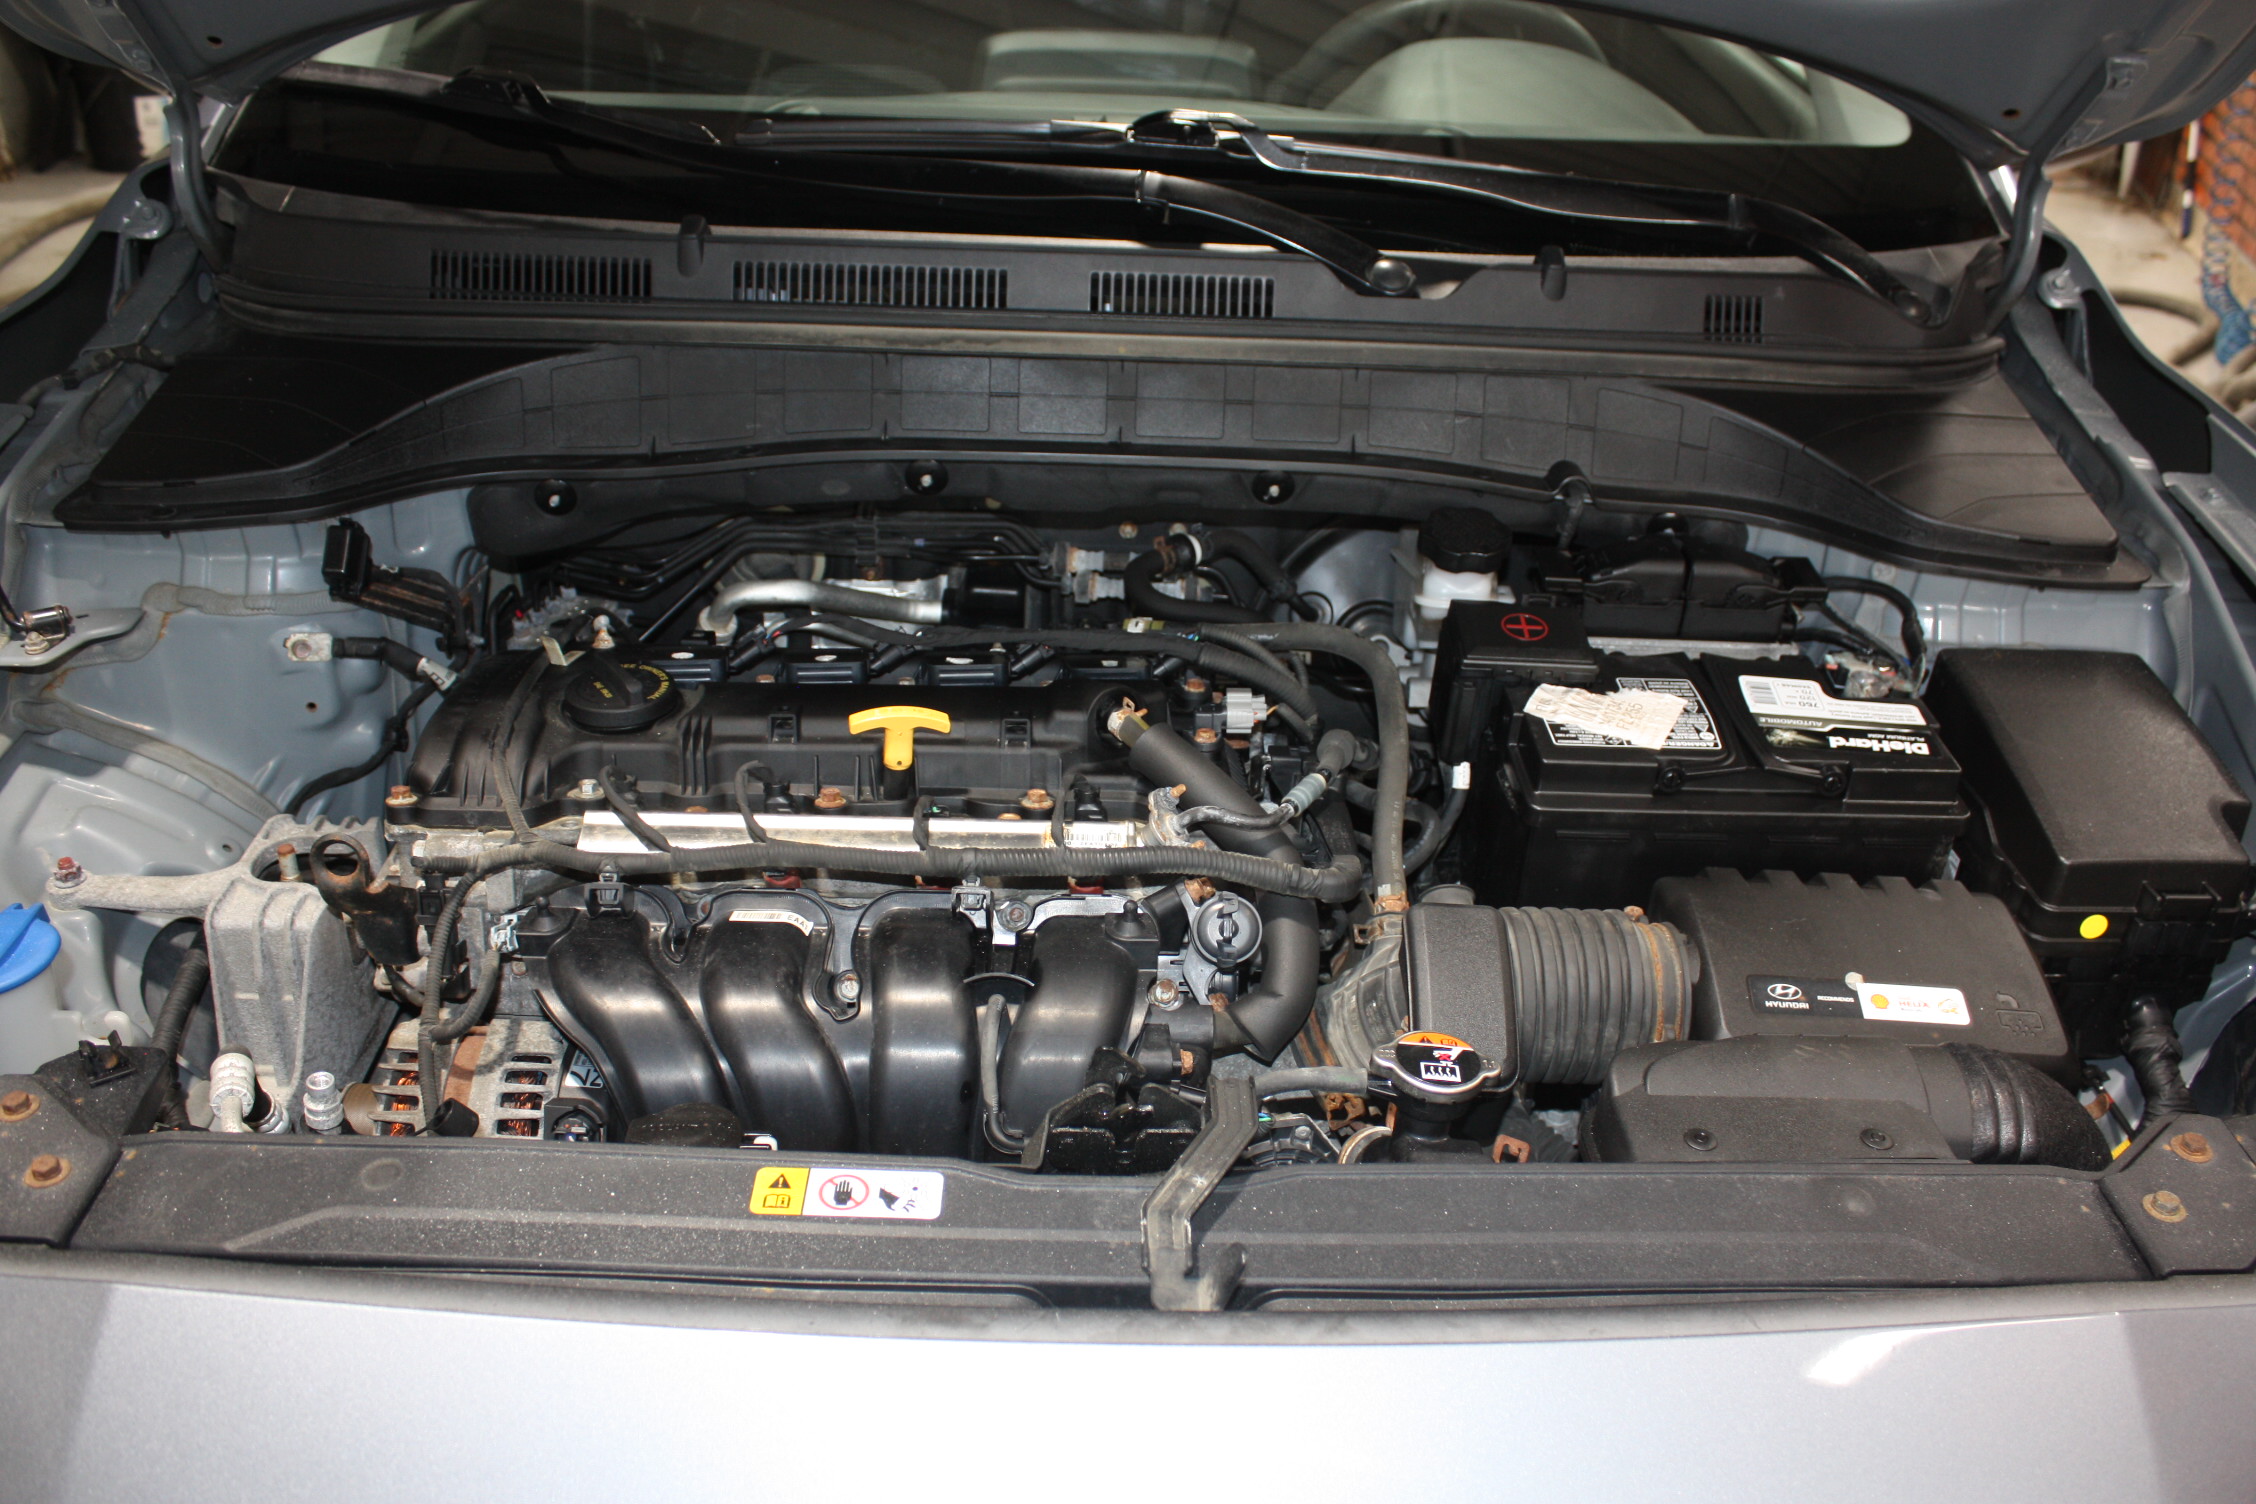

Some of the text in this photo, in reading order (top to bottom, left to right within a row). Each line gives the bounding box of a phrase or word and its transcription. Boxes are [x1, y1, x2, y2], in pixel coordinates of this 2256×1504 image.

[1759, 717, 1822, 726] AUTOMOBILE
[1828, 736, 1930, 754] DieHard
[1765, 1000, 1810, 1010] HYUNDAI
